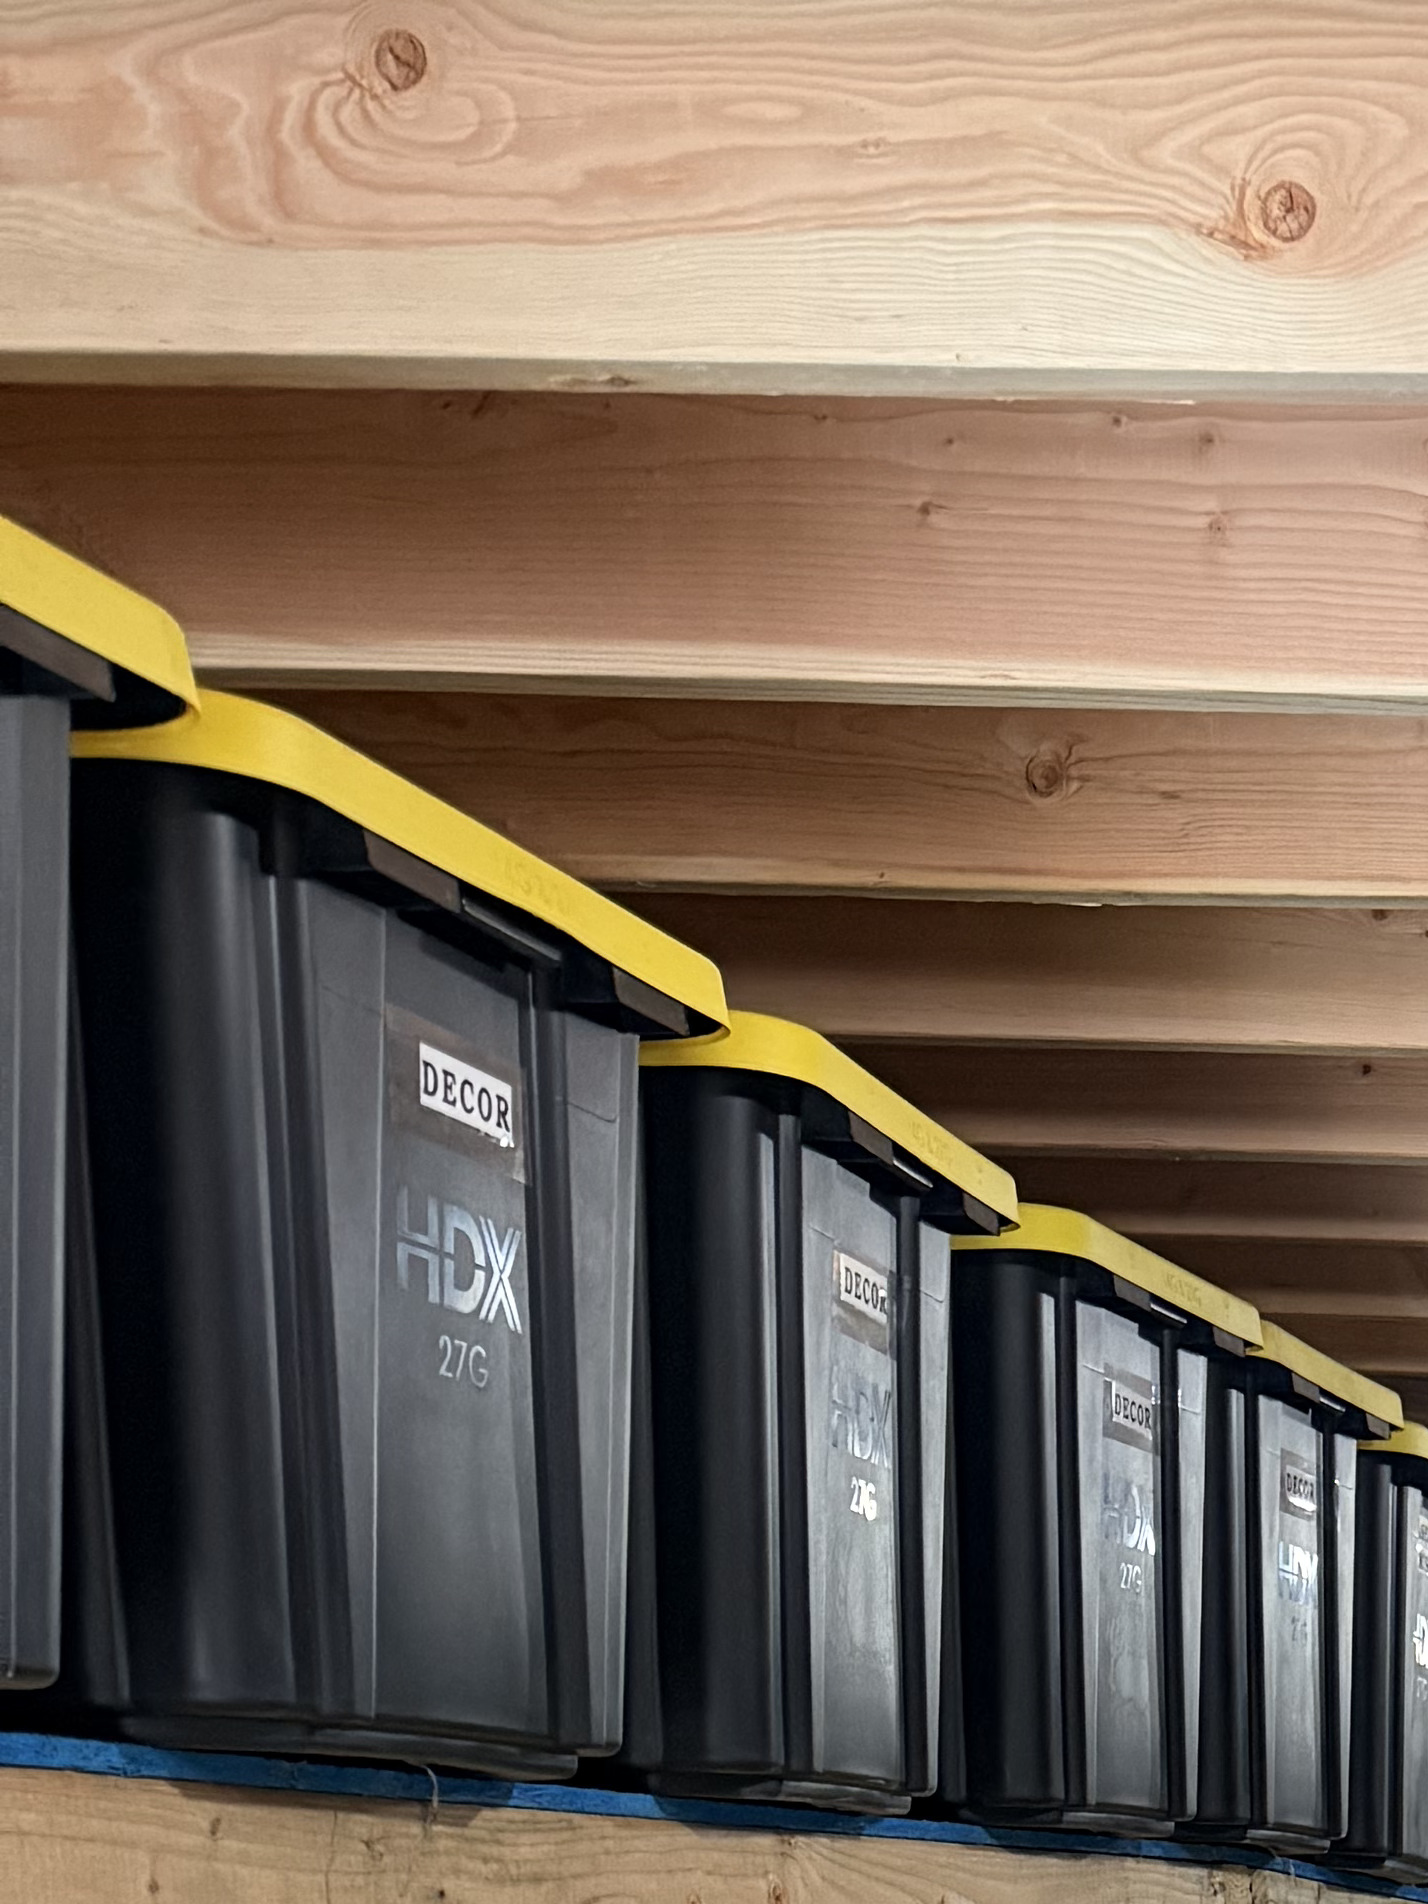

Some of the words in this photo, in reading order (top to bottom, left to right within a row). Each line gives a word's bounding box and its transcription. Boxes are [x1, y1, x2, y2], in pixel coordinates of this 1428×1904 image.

[421, 1058, 511, 1133] DECOR
[397, 1185, 522, 1335] HDX
[843, 1266, 888, 1315] DECOR
[438, 1335, 490, 1389] 27G
[1115, 1393, 1152, 1430] DECOR
